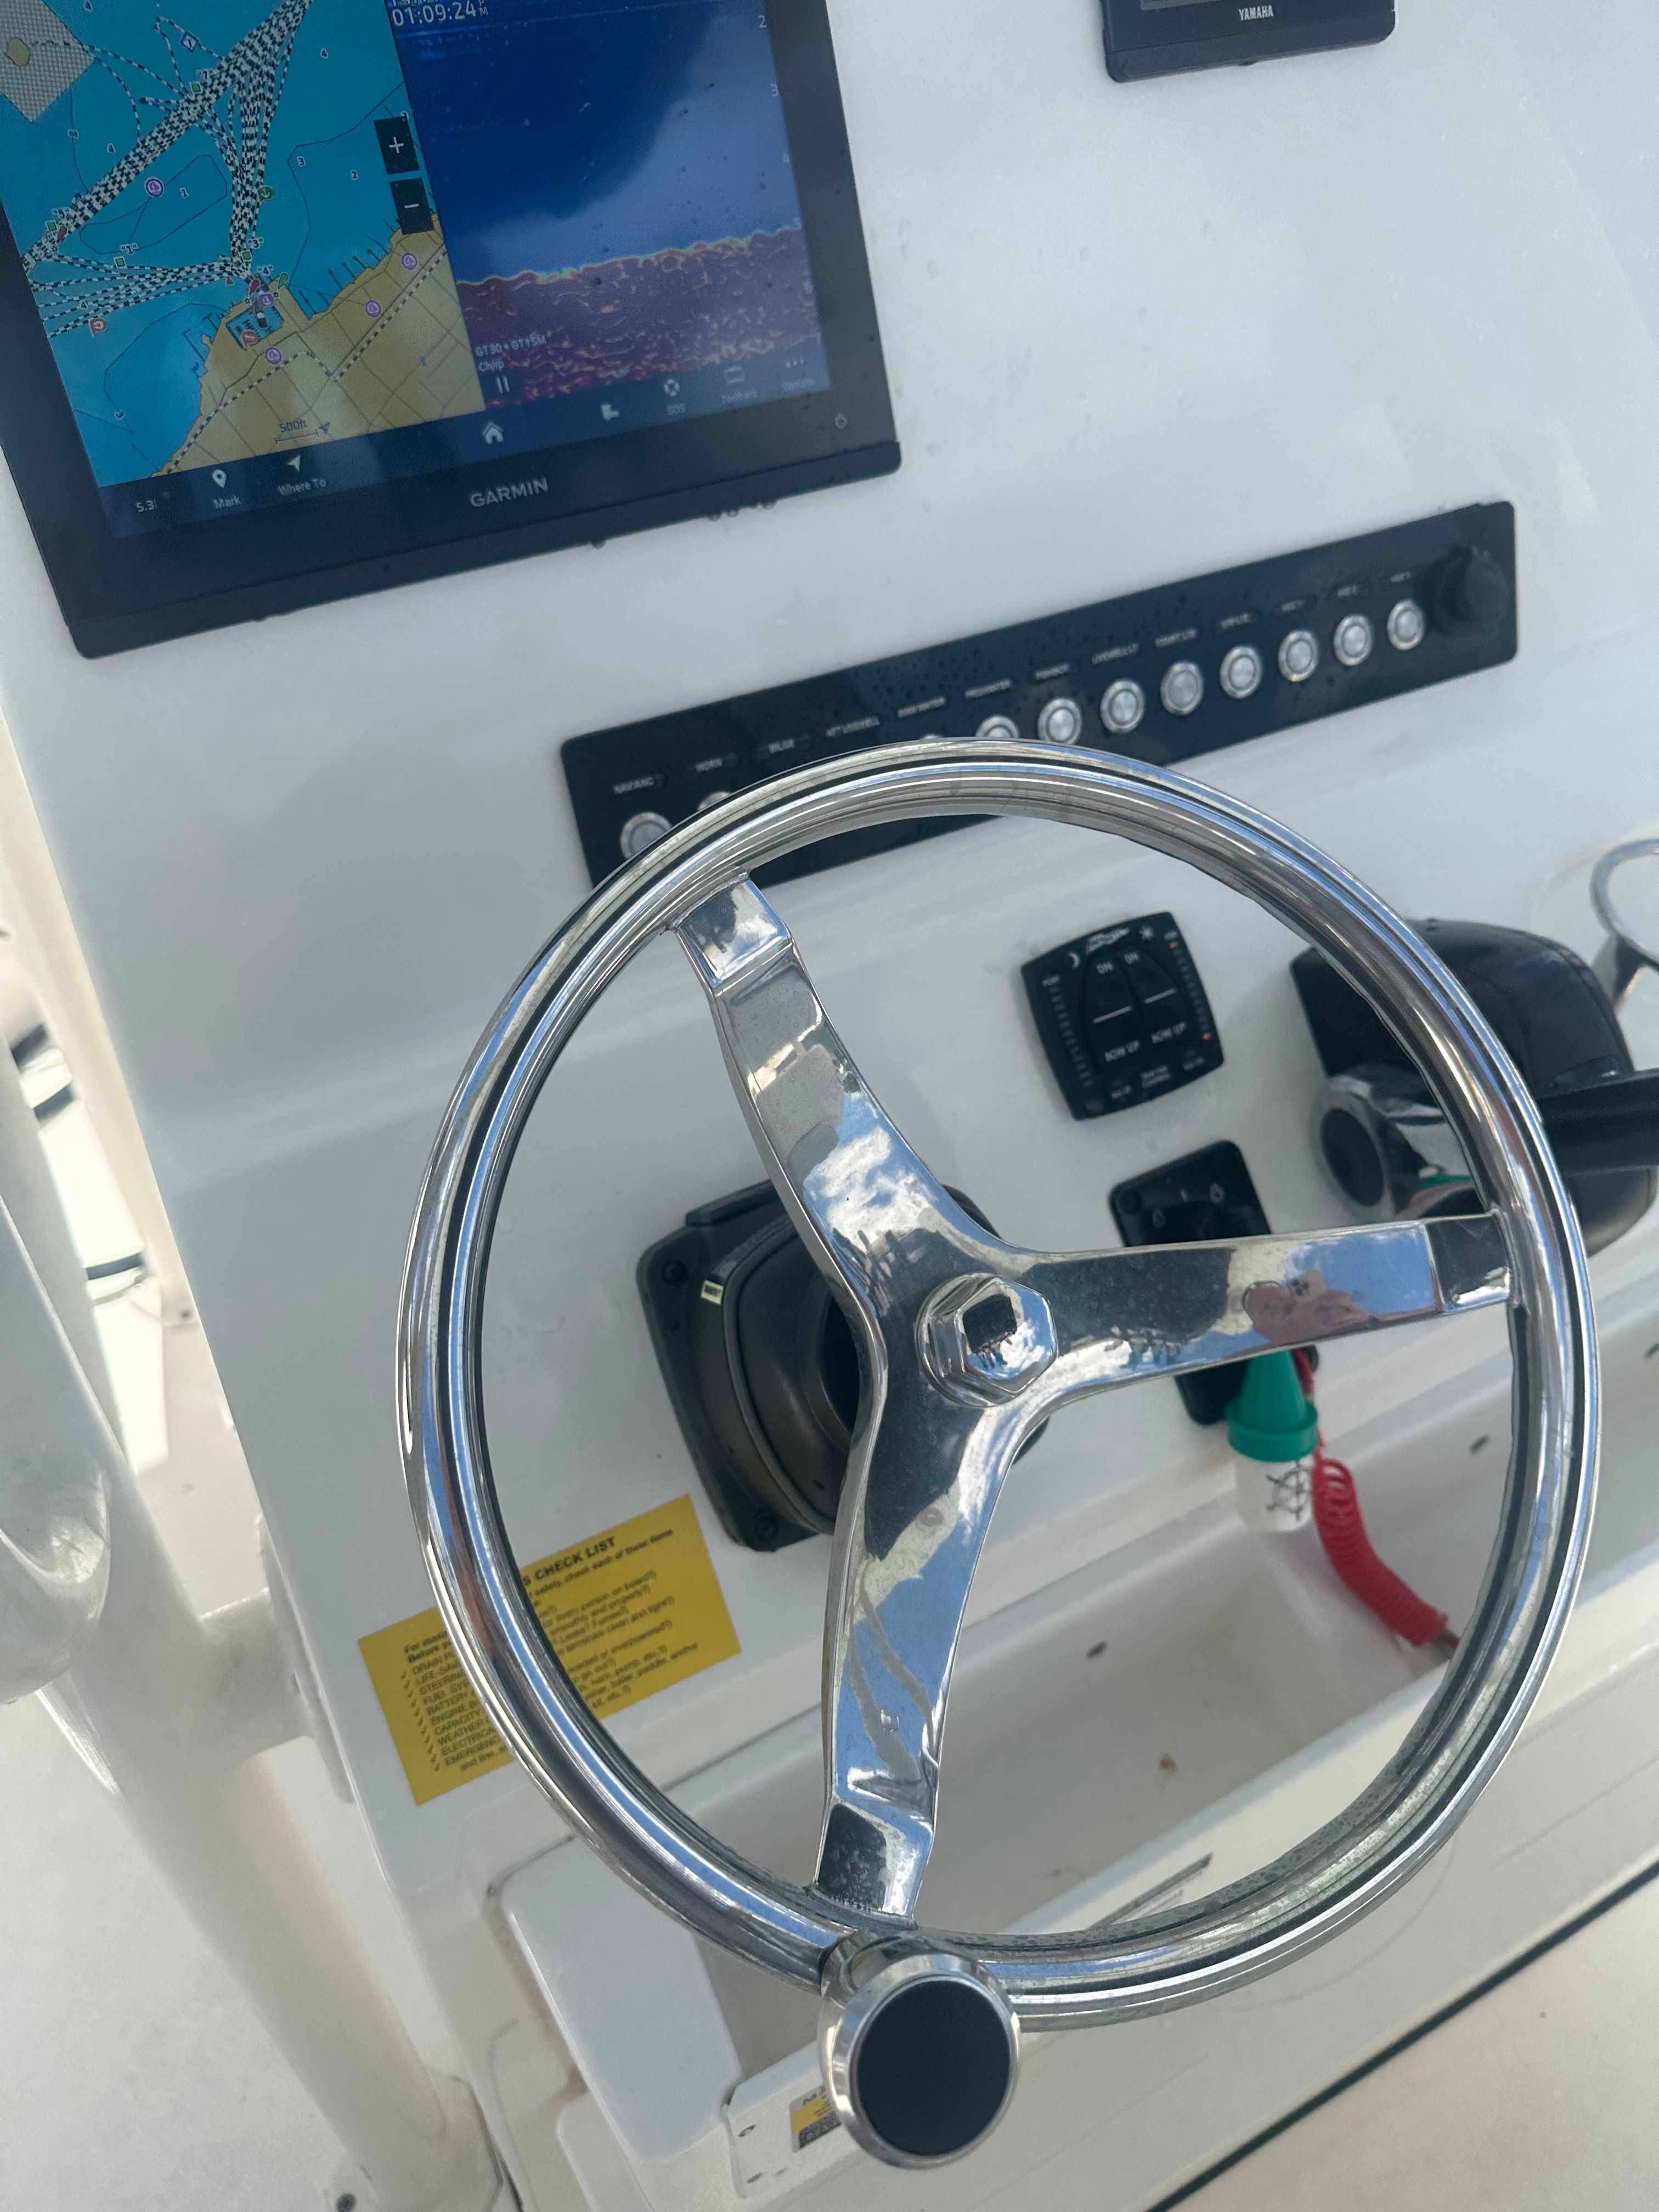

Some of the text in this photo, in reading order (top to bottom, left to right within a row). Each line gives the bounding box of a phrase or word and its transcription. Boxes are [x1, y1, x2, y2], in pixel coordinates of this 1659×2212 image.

[392, 1, 476, 26] 01:09:24
[758, 15, 767, 28] 2
[1238, 5, 1274, 21] YAMAHA
[770, 84, 778, 97] 3
[351, 171, 358, 180] 2
[277, 480, 311, 495] Where
[470, 476, 549, 507] GARMIN
[213, 494, 241, 510] Mark
[534, 1551, 583, 1581] CHECK
[585, 1536, 615, 1558] LIST
[404, 1643, 420, 1654] For
[408, 1645, 439, 1663] Before
[413, 1656, 442, 1675] DRAIN
[424, 1690, 446, 1705] FUEL
[427, 1692, 469, 1715] BATTERY
[430, 1703, 465, 1725] ENGINE
[434, 1709, 481, 1735] CAPACITY
[438, 1718, 484, 1745] WEATHER
[441, 1727, 496, 1755] ELECTRICA
[444, 1735, 500, 1765] EMERGENC
[460, 1758, 478, 1770] and
